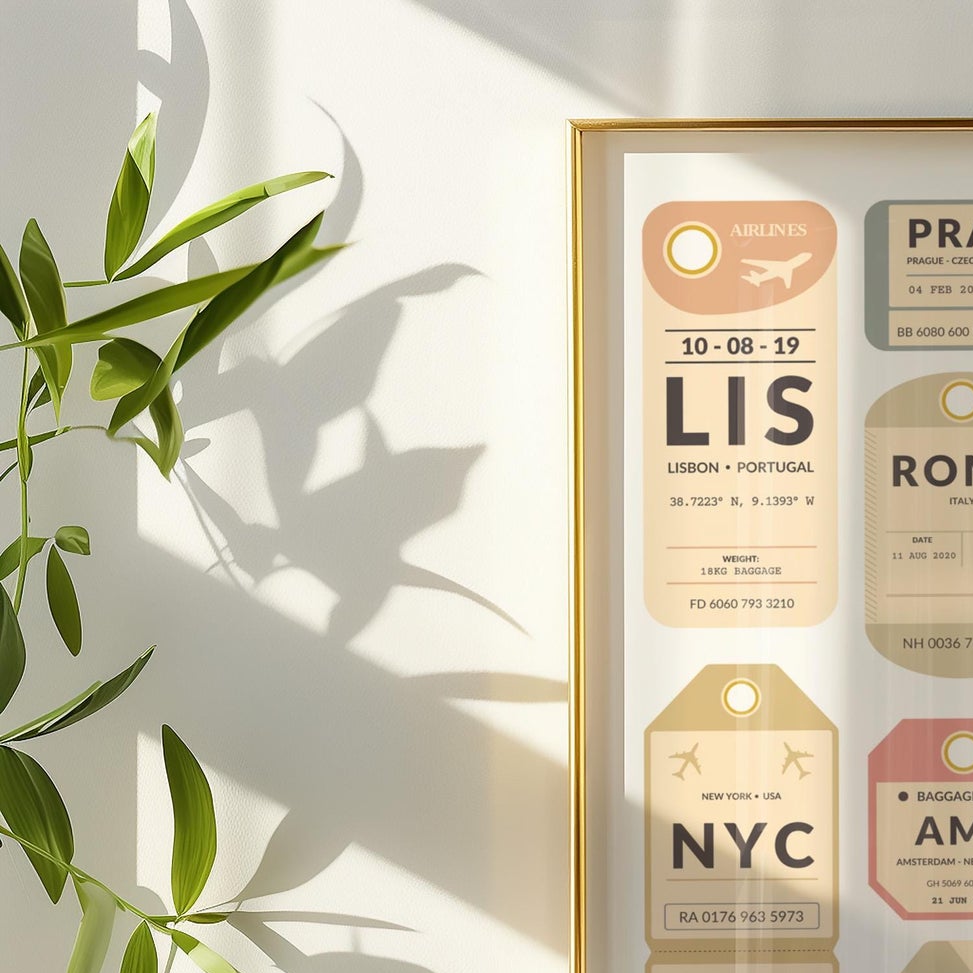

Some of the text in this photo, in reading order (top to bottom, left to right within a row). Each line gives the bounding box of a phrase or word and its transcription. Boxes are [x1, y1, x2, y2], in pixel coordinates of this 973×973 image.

[730, 224, 807, 237] AIRLINES
[907, 257, 944, 265] PRAGUE
[909, 285, 922, 294] 04
[930, 285, 952, 294] FEB
[897, 327, 913, 337] BB
[916, 327, 945, 337] 6080
[948, 327, 970, 337] 600
[682, 337, 708, 355] 10
[727, 337, 754, 355] 08
[774, 337, 799, 354] 19
[666, 375, 814, 446] LIS
[668, 461, 814, 473] LISBON PORTUGAL
[731, 497, 743, 507] N,
[805, 496, 815, 505] W
[722, 555, 759, 563] WEIGHT:
[701, 567, 781, 575] 18KG BAGGAGE
[690, 598, 794, 609] FD 6060 793 3210
[903, 638, 924, 649] NH
[928, 637, 961, 649] 0036
[726, 792, 752, 800] YORK
[763, 792, 781, 800] USA
[673, 822, 814, 869] NYC
[896, 858, 955, 866] AMSTERDAM
[680, 911, 804, 923] RA 0176 963 5973
